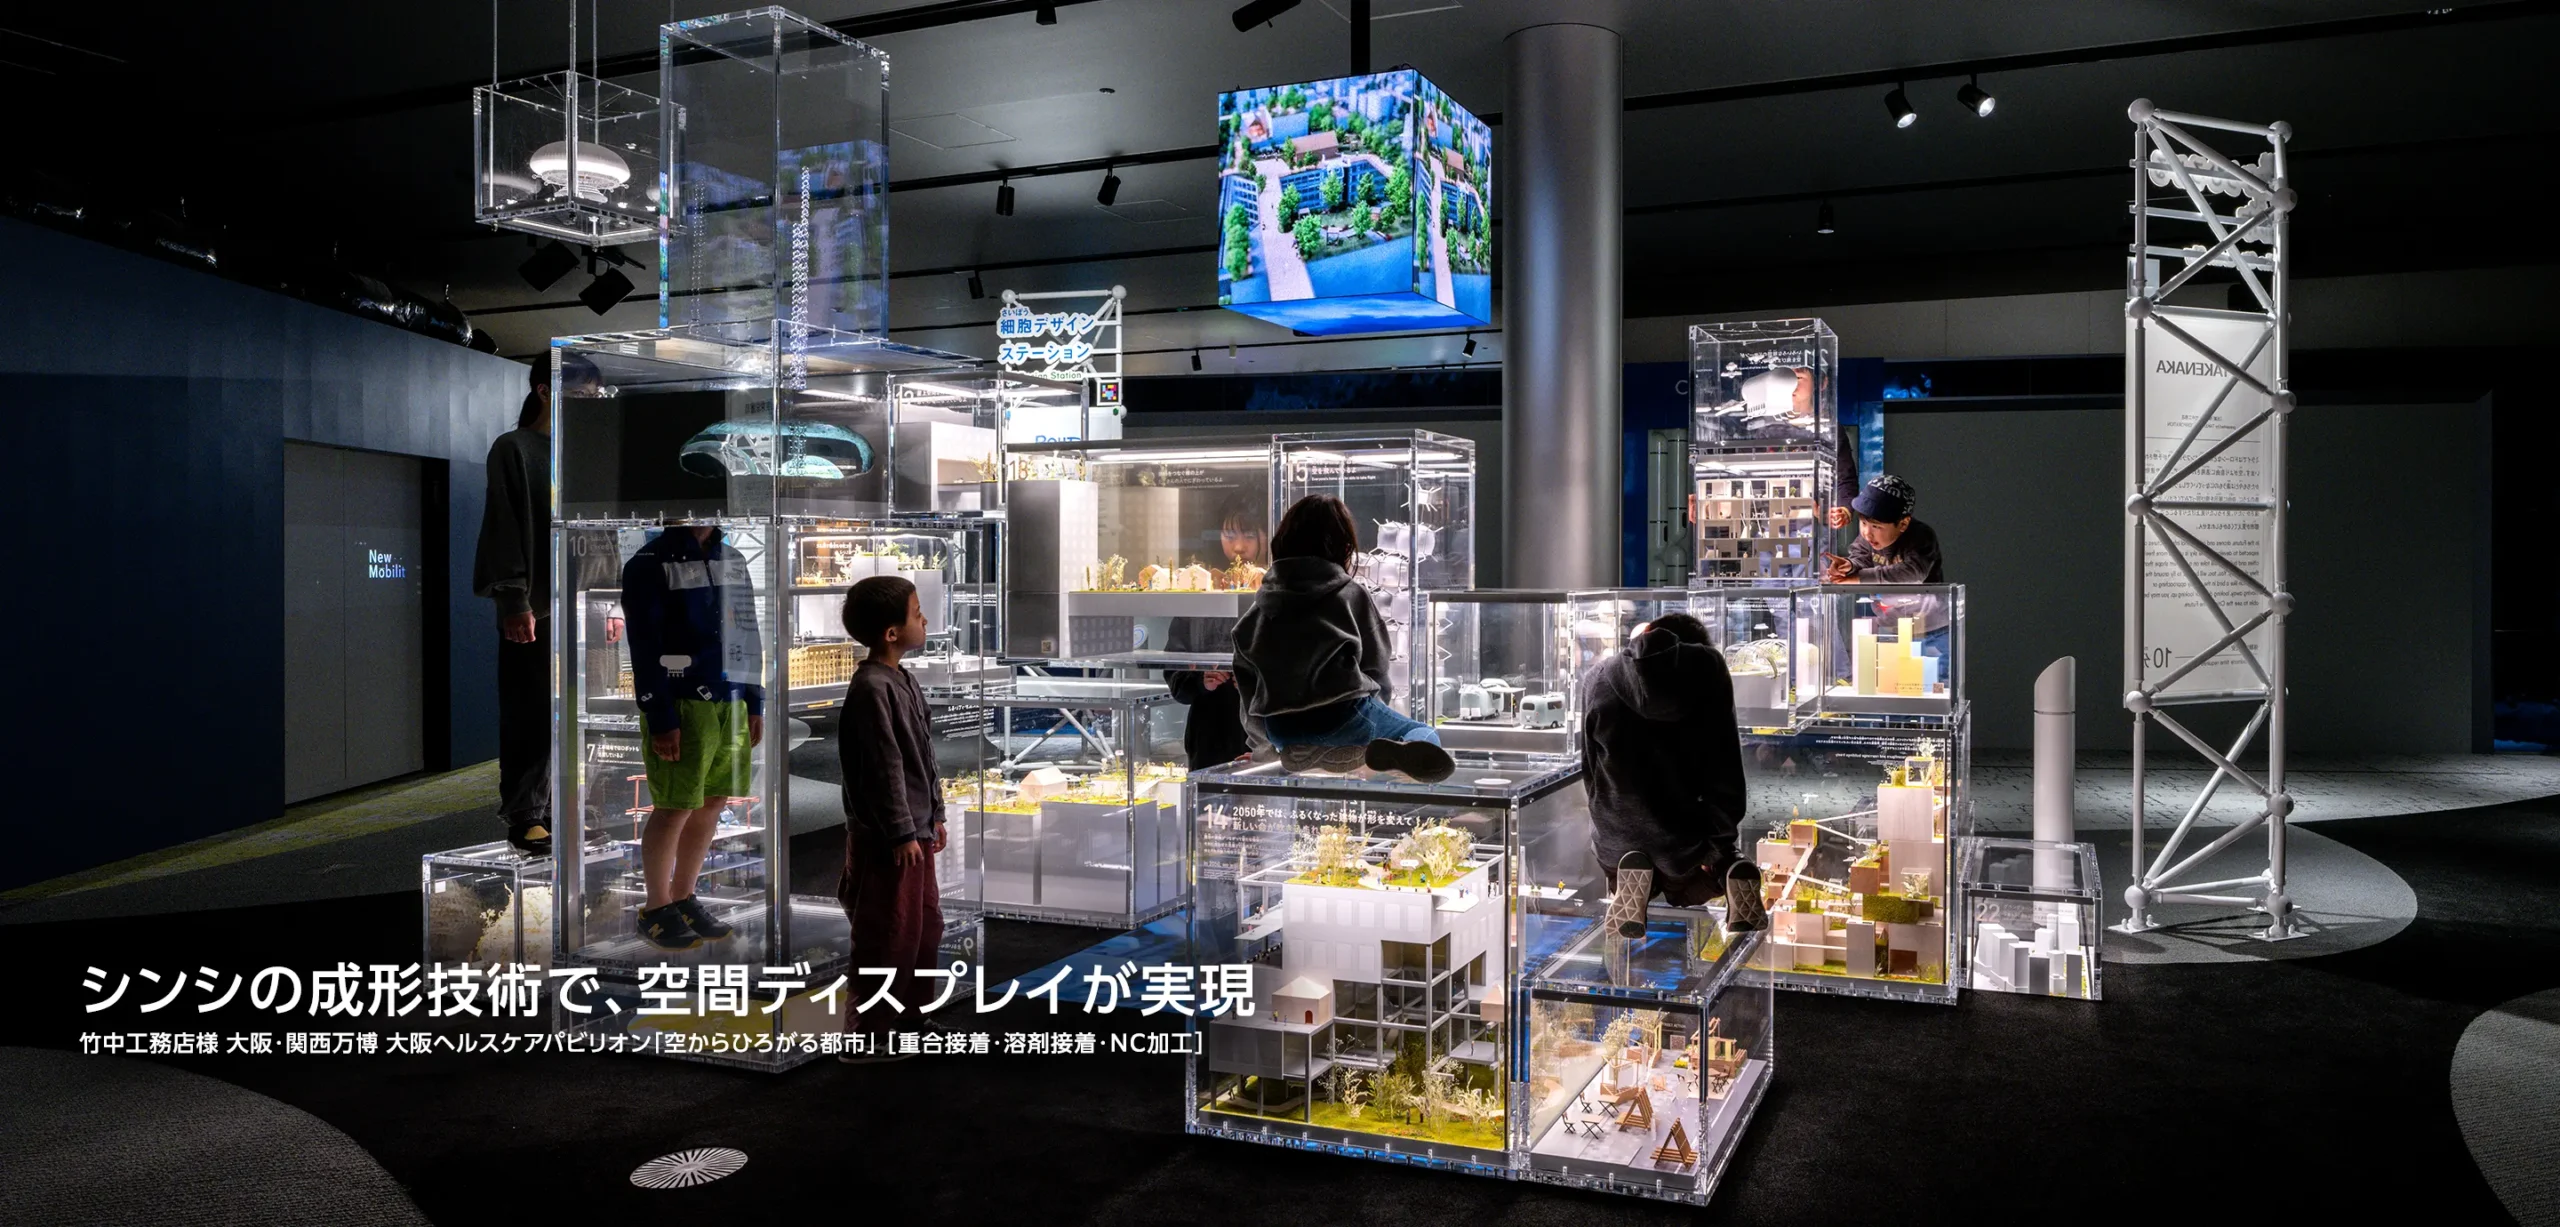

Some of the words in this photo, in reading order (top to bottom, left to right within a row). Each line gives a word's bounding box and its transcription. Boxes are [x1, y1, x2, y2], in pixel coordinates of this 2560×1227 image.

[1000, 316, 1095, 335] 細胞デザイン
[1001, 346, 1090, 362] ステーション
[1050, 371, 1082, 380] Station
[368, 549, 392, 563] New
[586, 743, 596, 762] 7
[1203, 803, 1229, 830] 14
[1977, 902, 2001, 922] 22
